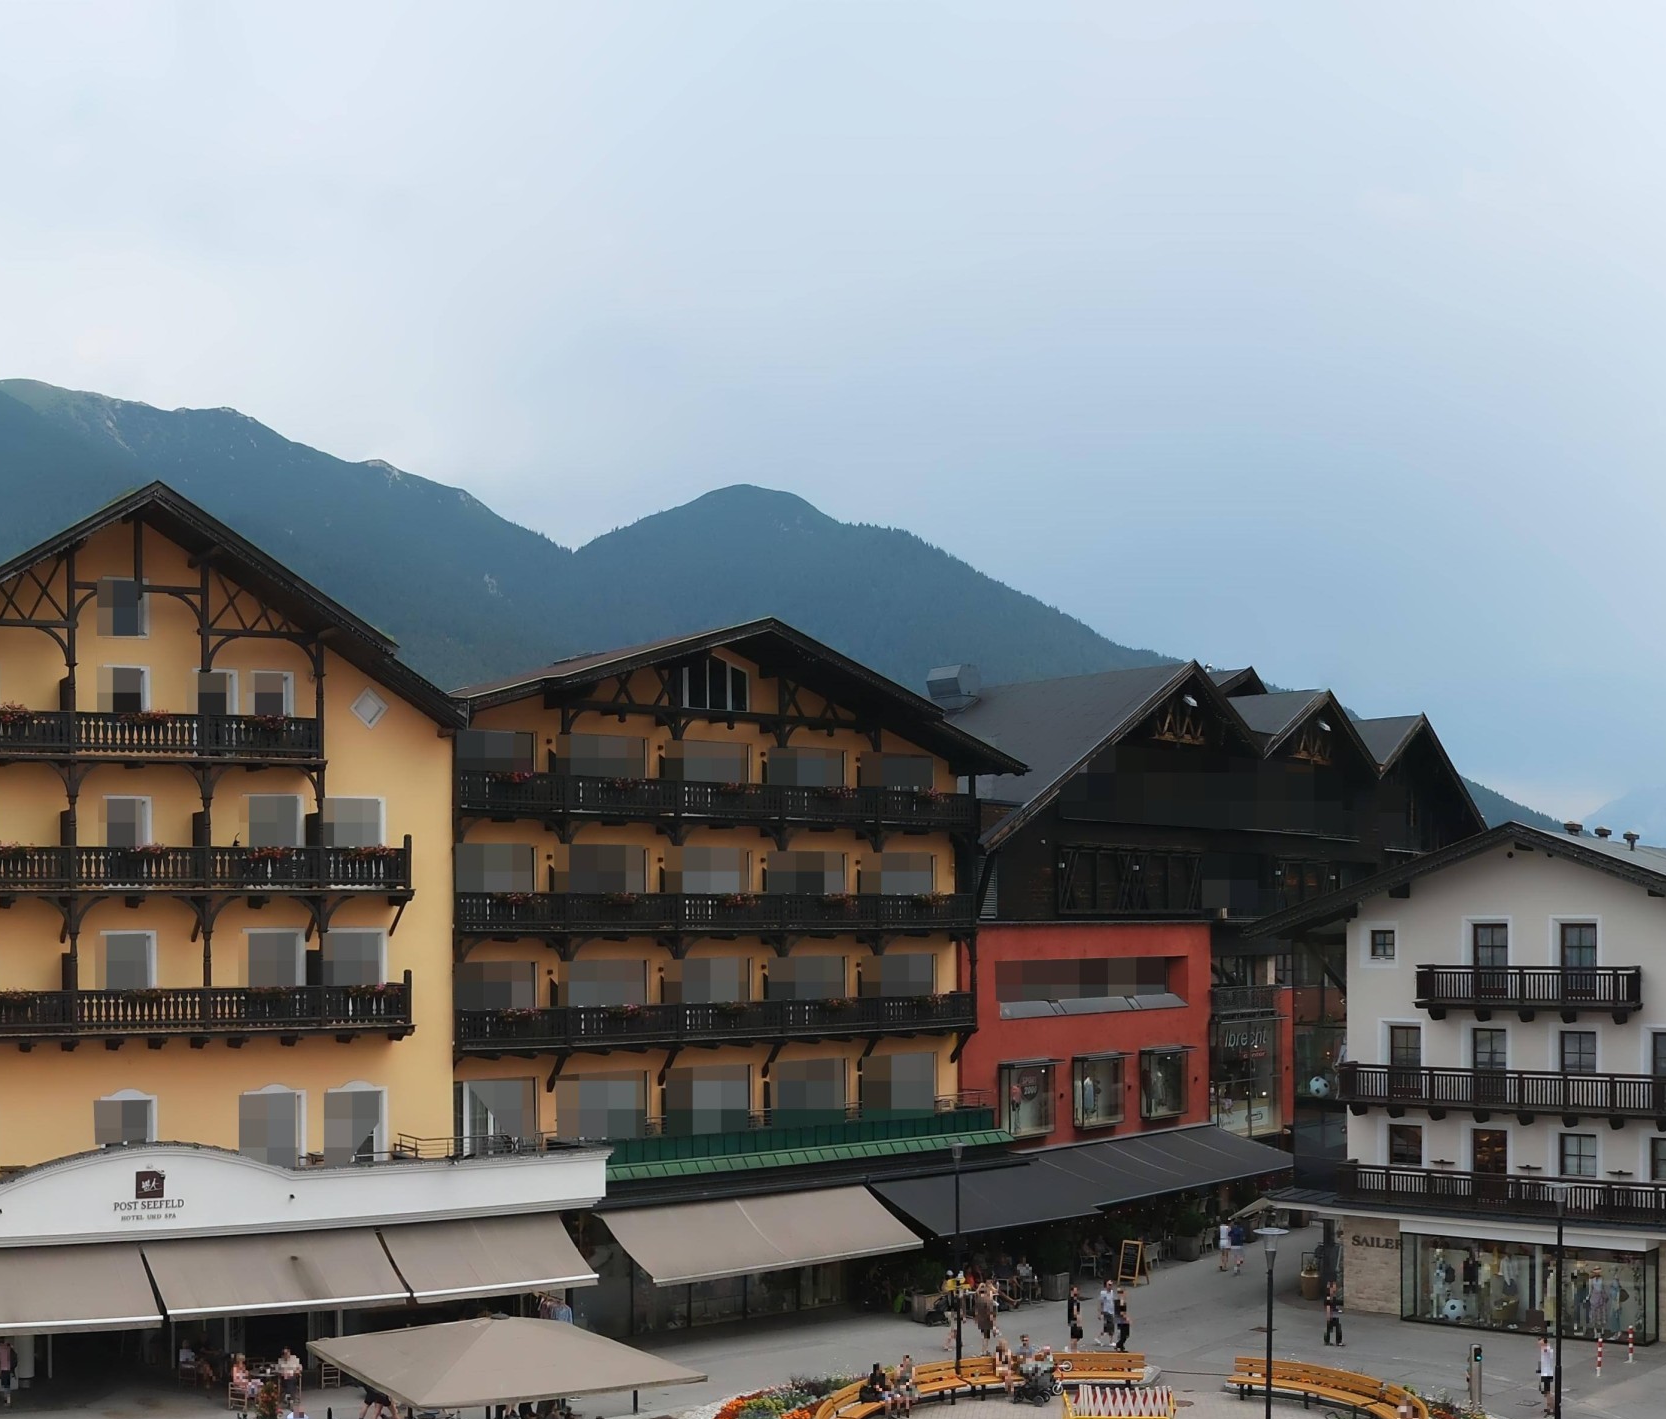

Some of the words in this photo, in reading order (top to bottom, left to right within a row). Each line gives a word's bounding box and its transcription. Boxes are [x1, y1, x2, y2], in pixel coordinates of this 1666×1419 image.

[1219, 1026, 1267, 1047] lbreht
[113, 1201, 139, 1212] POST
[141, 1199, 185, 1210] SEEFELD
